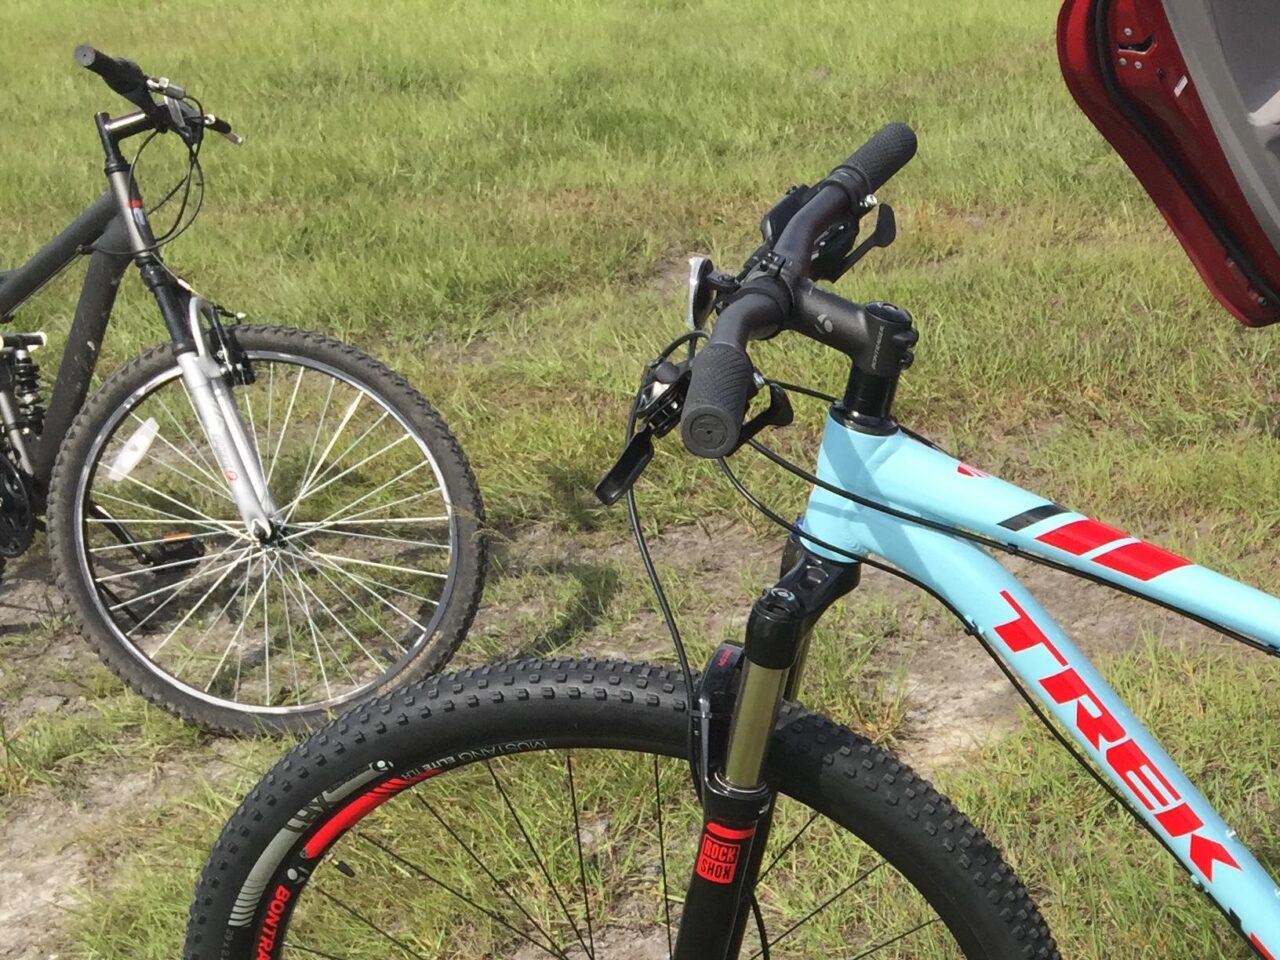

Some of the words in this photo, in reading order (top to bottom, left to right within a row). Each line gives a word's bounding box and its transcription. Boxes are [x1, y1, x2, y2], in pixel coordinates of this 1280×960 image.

[871, 325, 885, 370] BONTRAGER
[993, 590, 1242, 882] TREK
[458, 739, 547, 761] MUSTANG
[422, 756, 456, 770] ELITE
[704, 839, 736, 863] ROCK
